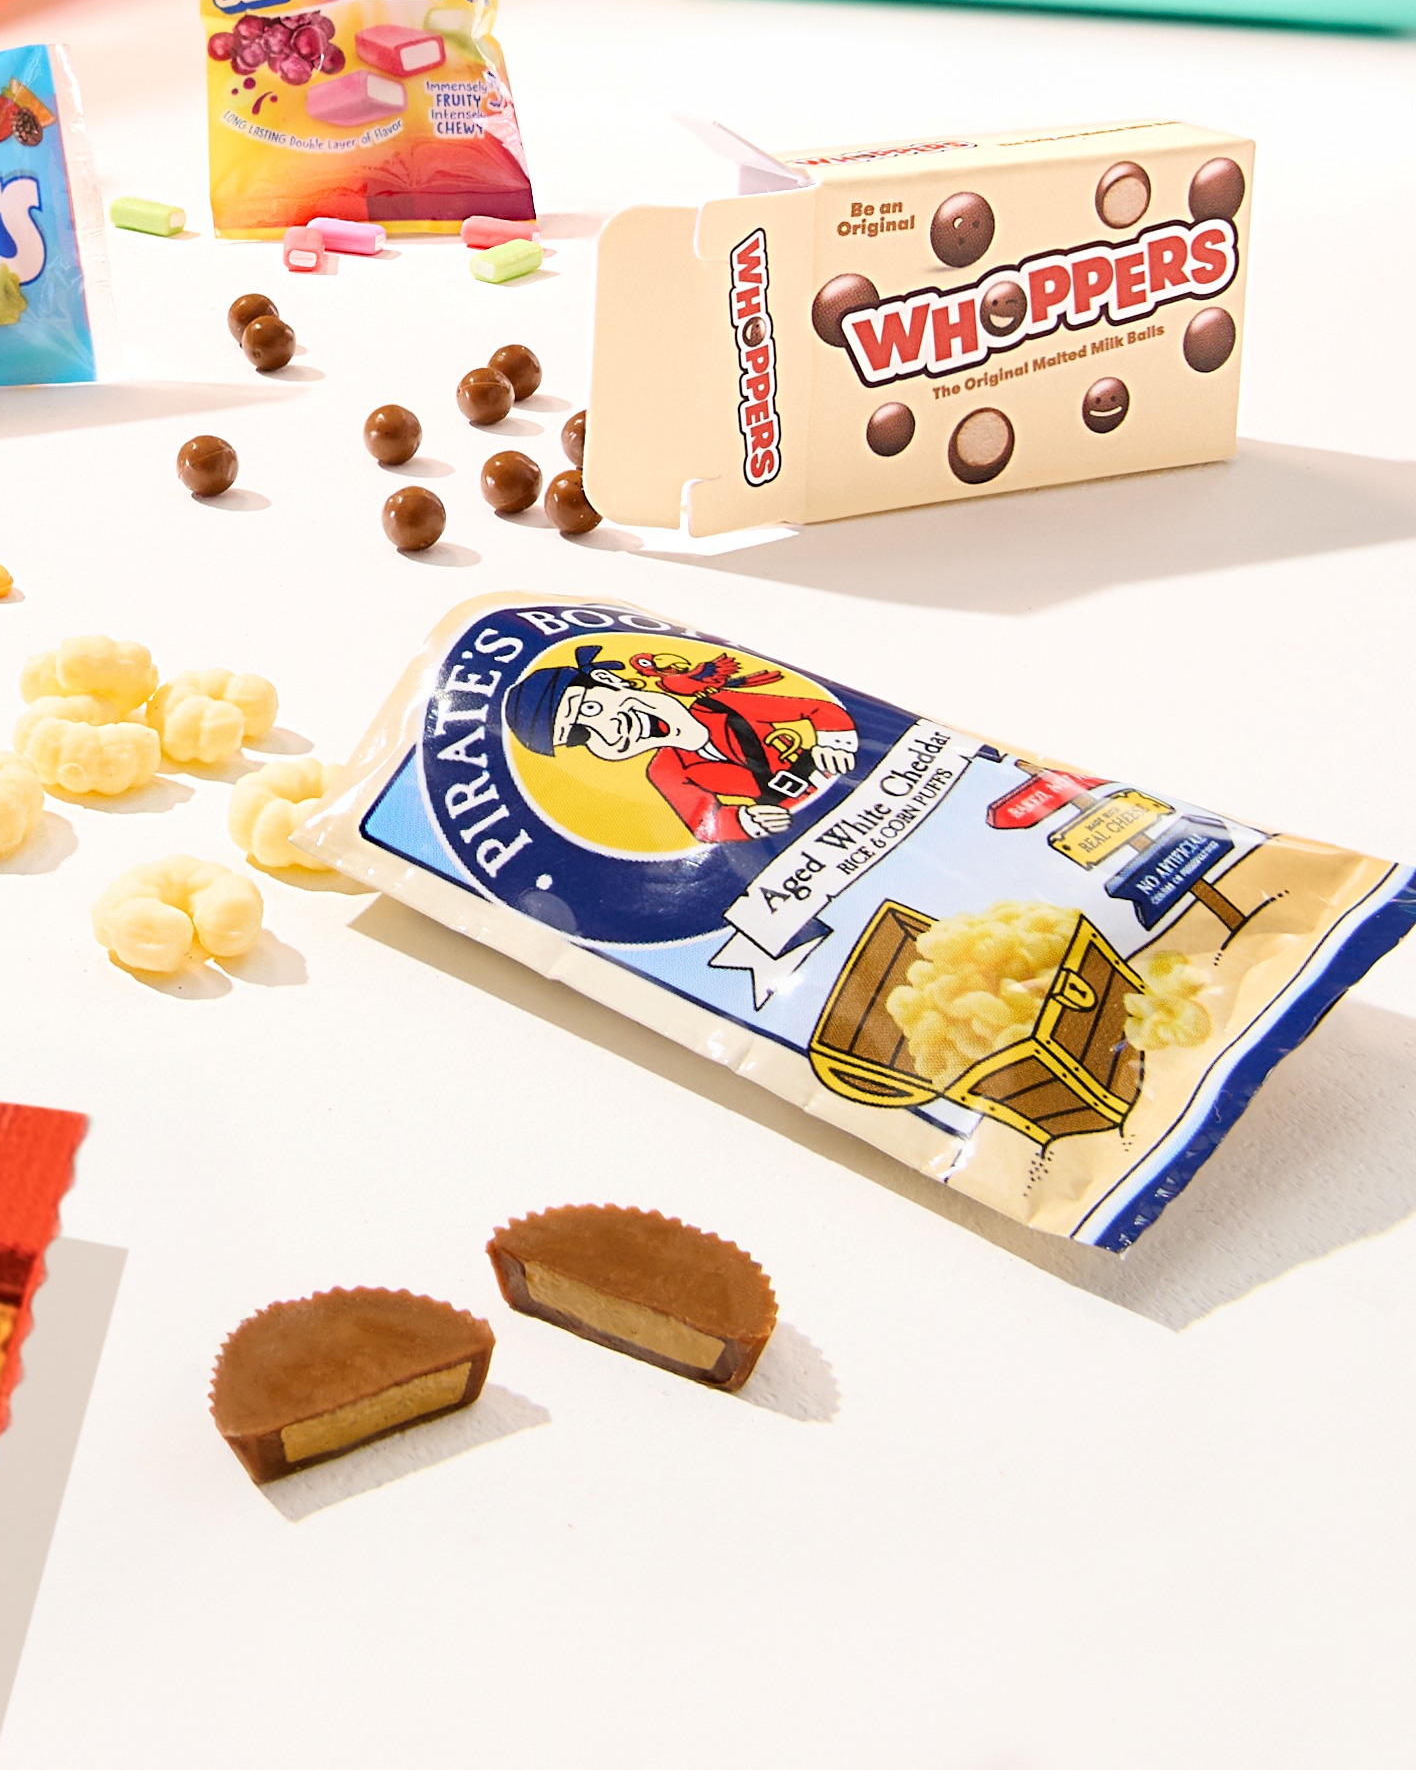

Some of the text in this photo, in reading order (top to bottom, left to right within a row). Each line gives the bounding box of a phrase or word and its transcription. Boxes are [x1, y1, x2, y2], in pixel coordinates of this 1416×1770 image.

[436, 93, 481, 108] FRUITY
[223, 110, 247, 131] LONG
[249, 125, 287, 145] LASTING
[289, 135, 324, 150] Double
[327, 139, 357, 151] Layer
[361, 133, 372, 145] of
[437, 121, 484, 135] CHEWY
[836, 214, 916, 238] Original
[850, 201, 903, 218] Be an
[851, 227, 1229, 373] WHOPPERS
[733, 237, 776, 481] WHOPPERS
[931, 323, 1166, 401] The Original Malted Milk Balls
[436, 627, 533, 877] PIRATE'S
[759, 730, 952, 915] Aged White Cheddar
[835, 767, 953, 876] RICE & CORN PUFFS
[1078, 826, 1112, 854] REAL
[1135, 872, 1161, 897] NO
